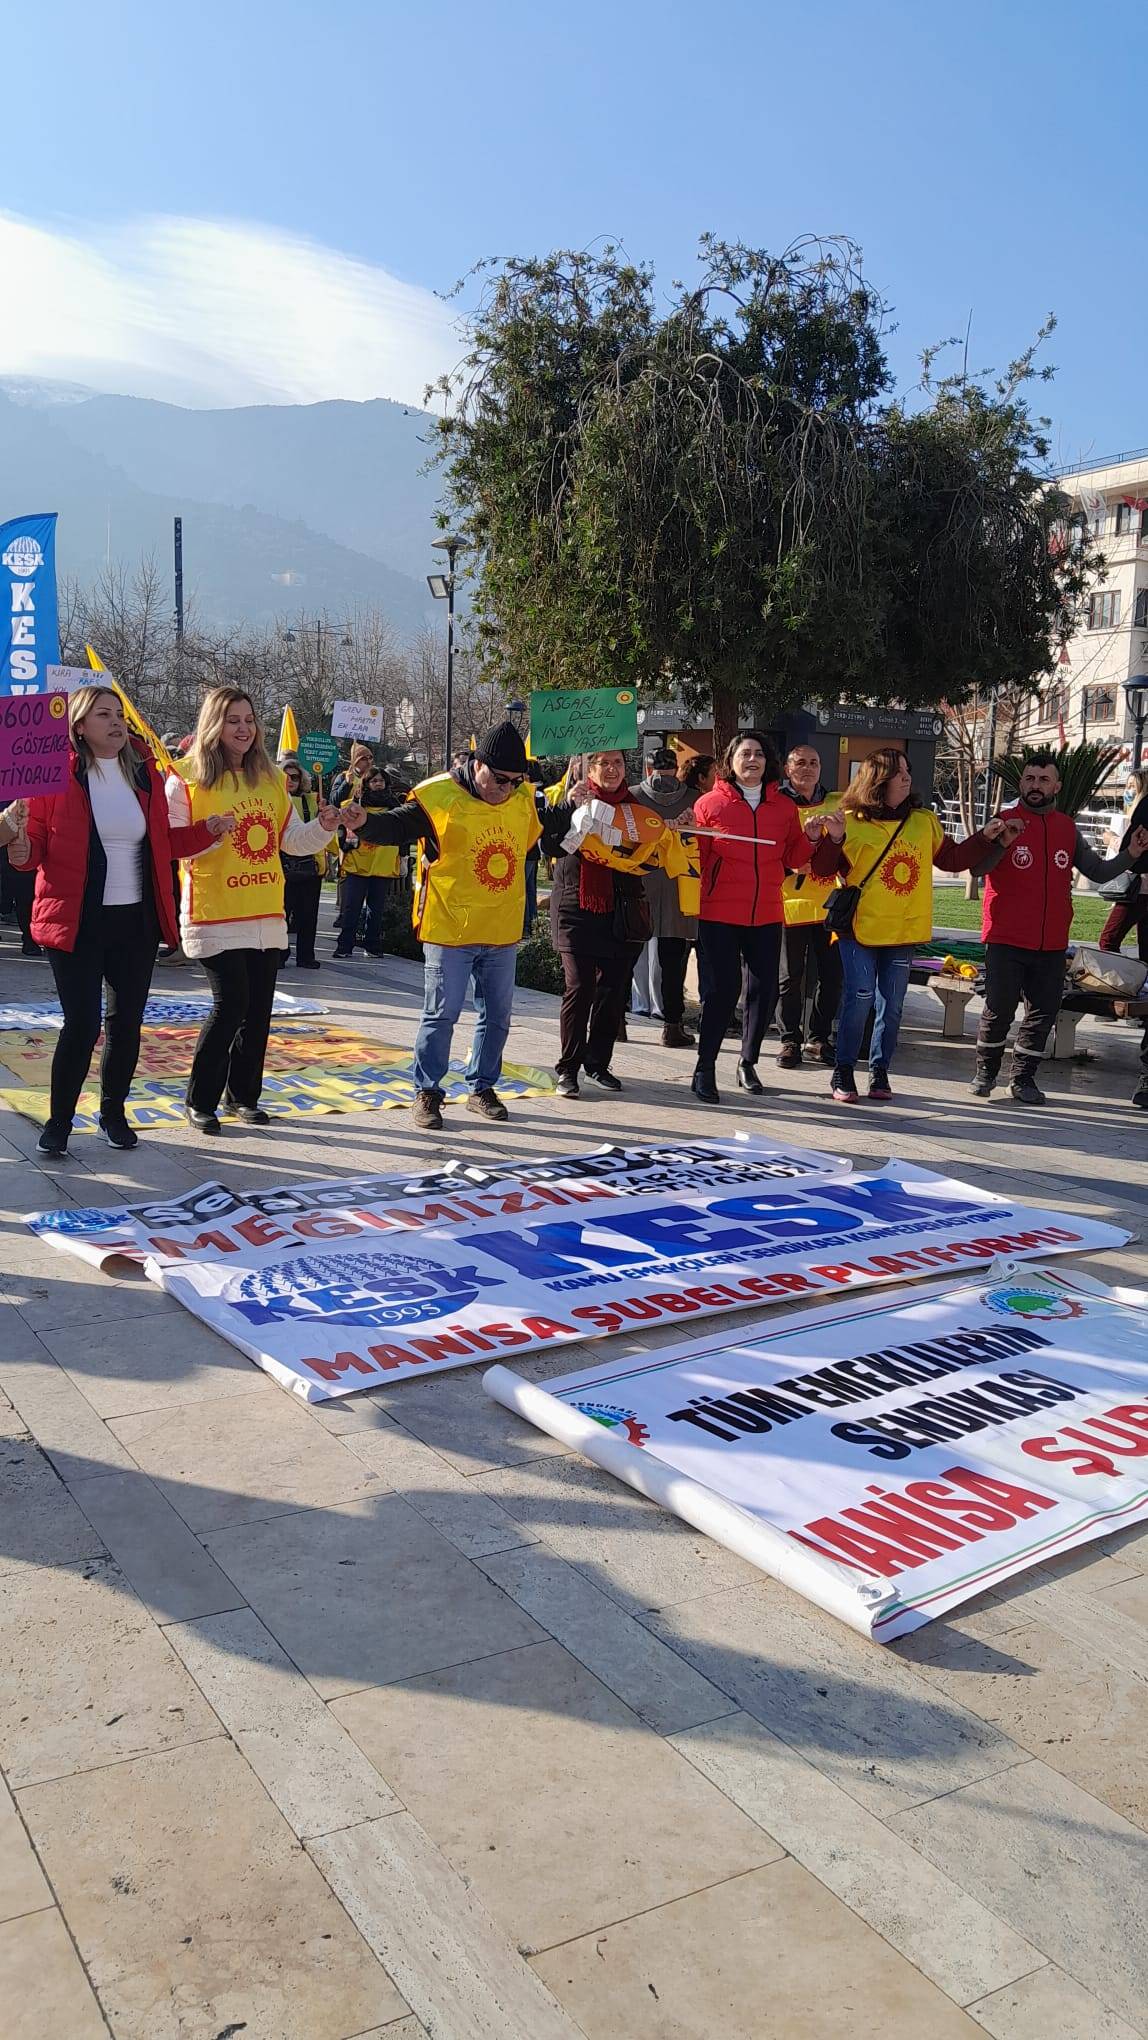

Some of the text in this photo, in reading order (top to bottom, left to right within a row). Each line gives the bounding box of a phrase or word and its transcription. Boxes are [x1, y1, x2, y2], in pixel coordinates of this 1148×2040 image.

[2, 552, 45, 566] KESK
[0, 701, 44, 728] 600
[143, 1185, 389, 1223] Sealet
[453, 1178, 988, 1280] KESK
[228, 1265, 507, 1325] KESK
[543, 1272, 622, 1292] KAMU
[622, 1250, 742, 1281] EMEKÇİLERİ
[301, 1226, 1085, 1381] MANİSA ŞUBELER PLATFORMU
[366, 1303, 441, 1325] 1995
[665, 1324, 1055, 1442] TÜM EMEKLİLERİN
[831, 1368, 1090, 1460] SENDİKASI
